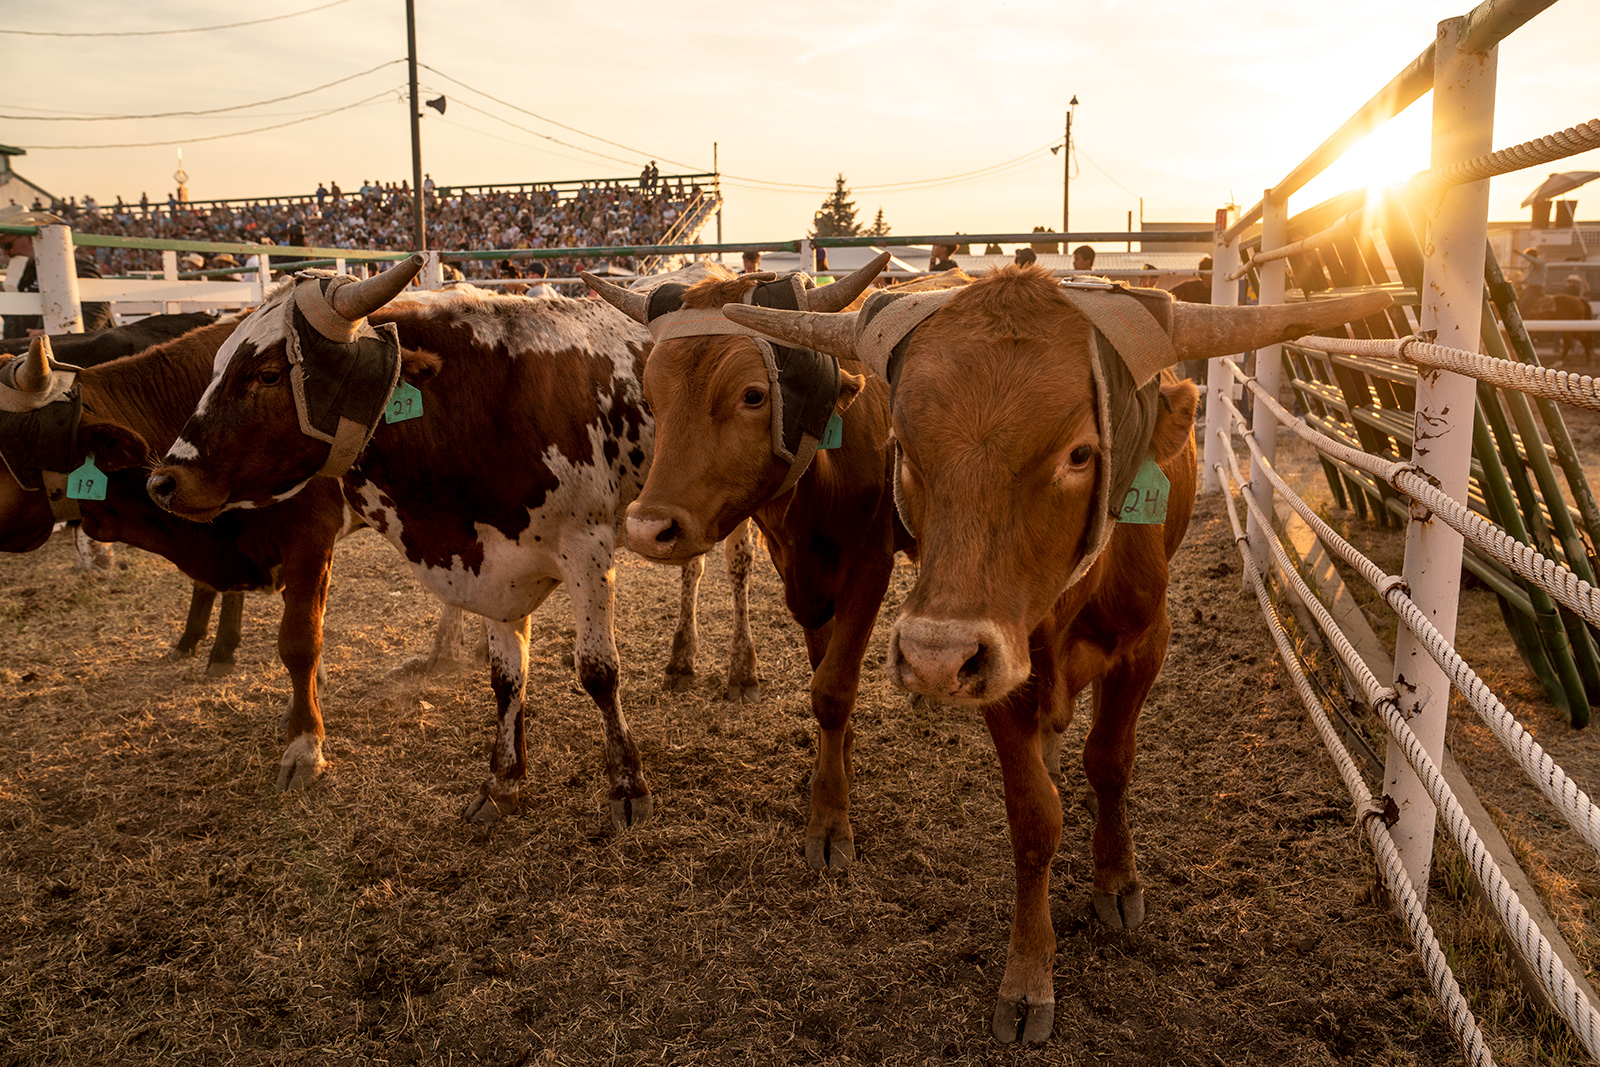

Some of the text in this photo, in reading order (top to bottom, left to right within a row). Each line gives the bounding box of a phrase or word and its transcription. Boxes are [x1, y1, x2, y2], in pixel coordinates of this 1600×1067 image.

[393, 398, 413, 416] 29
[77, 479, 94, 494] 19
[1123, 487, 1160, 514] 24
